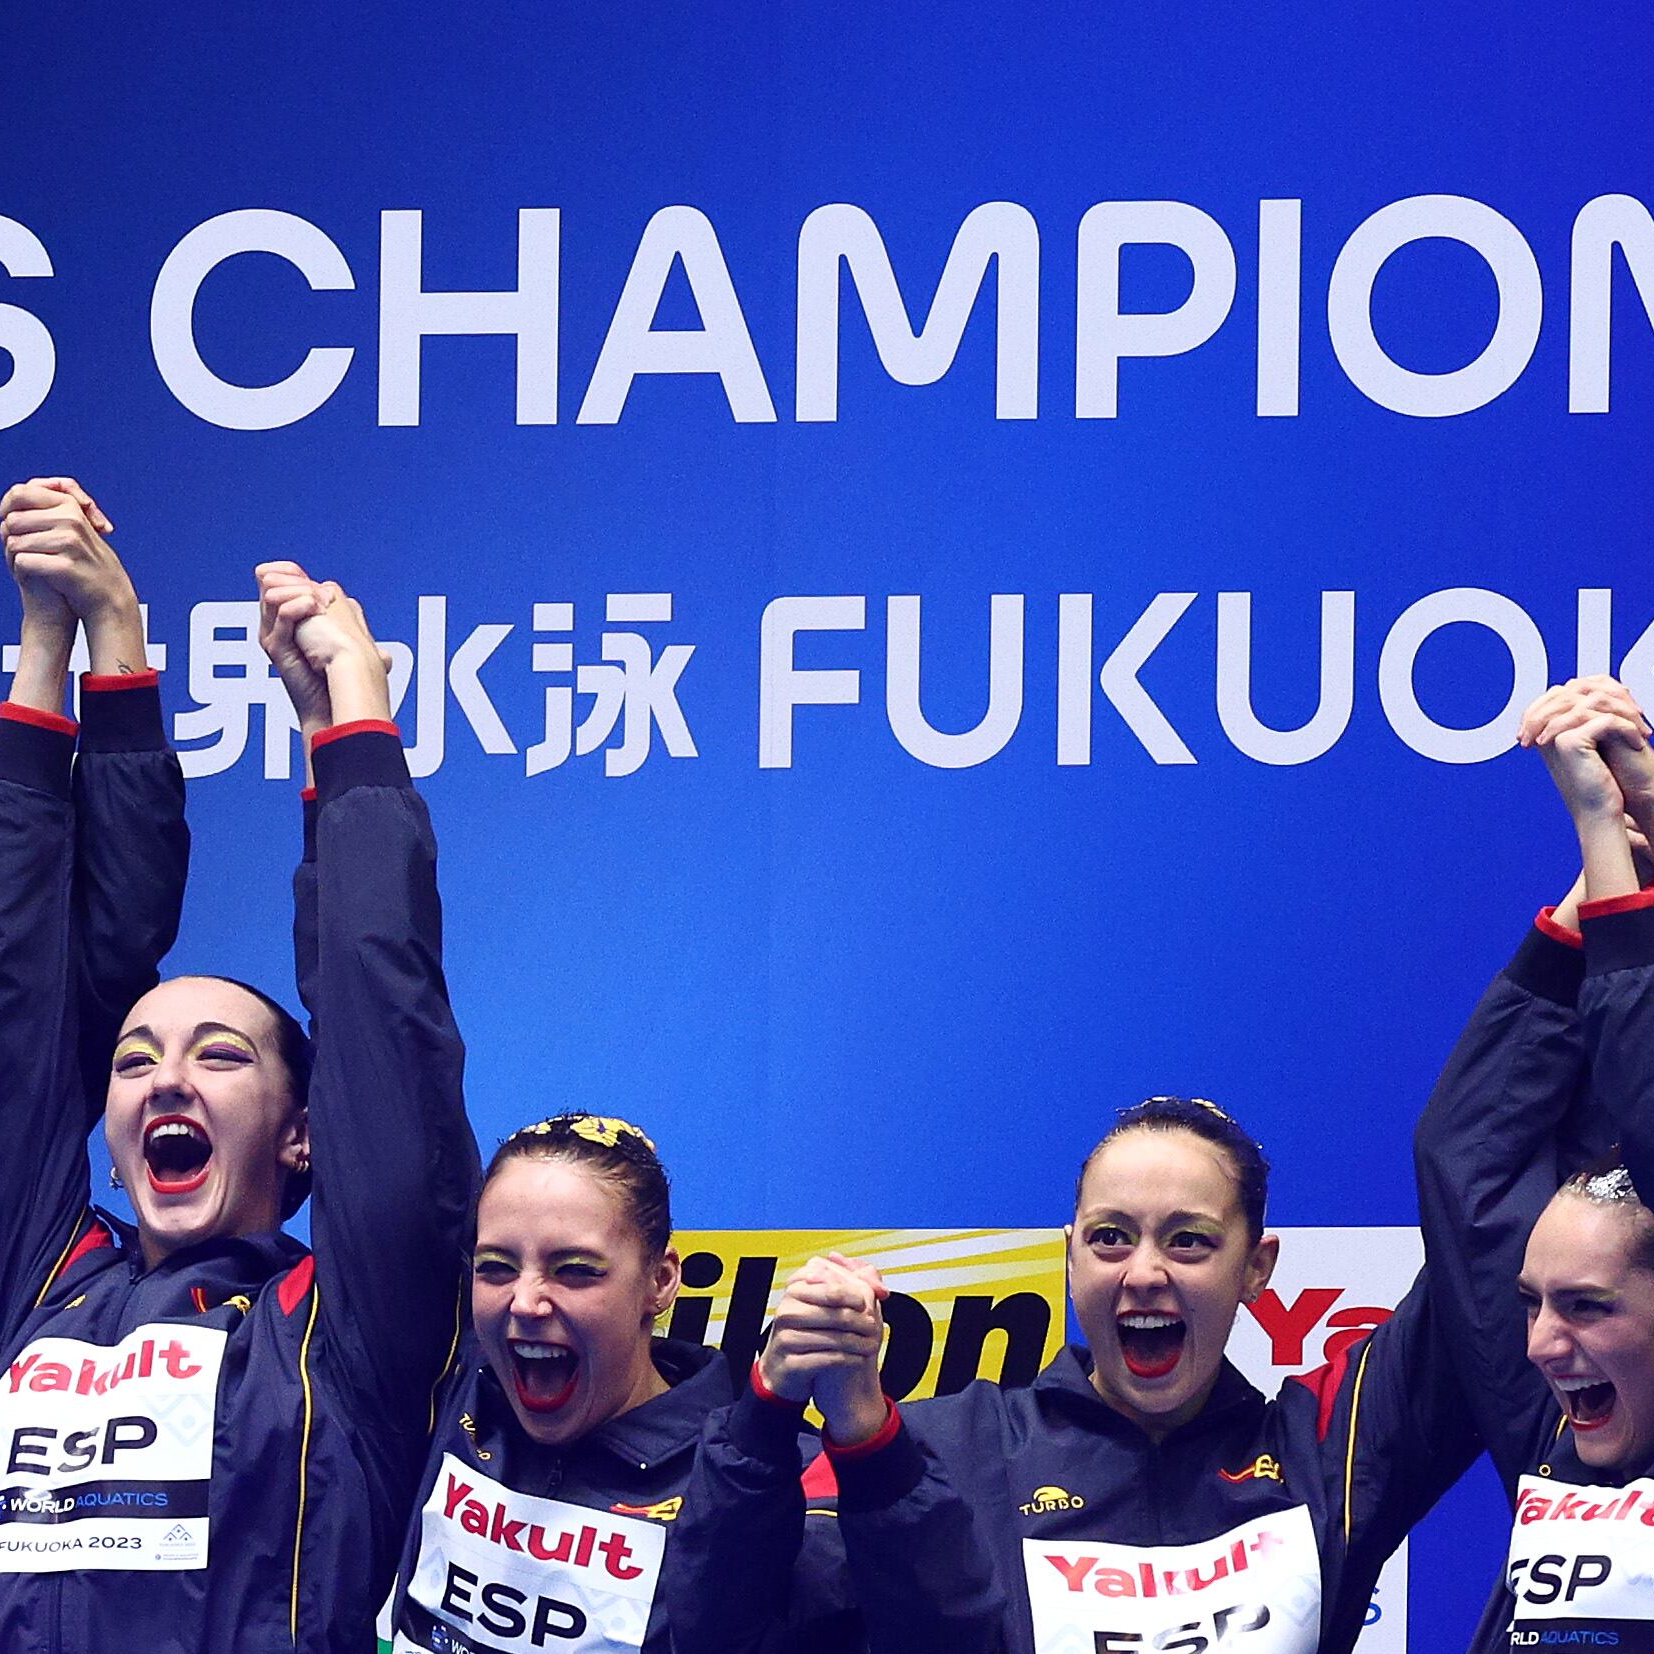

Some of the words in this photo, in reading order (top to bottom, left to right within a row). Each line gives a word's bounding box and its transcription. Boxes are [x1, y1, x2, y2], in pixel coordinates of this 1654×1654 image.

[6, 1415, 158, 1476] ESP
[10, 1497, 75, 1515] WORLD
[76, 1492, 169, 1508] AQUATICS
[1018, 1495, 1085, 1516] TURBO
[88, 1535, 143, 1551] 2023
[443, 1472, 644, 1581] Yakult
[440, 1561, 587, 1647] ESP
